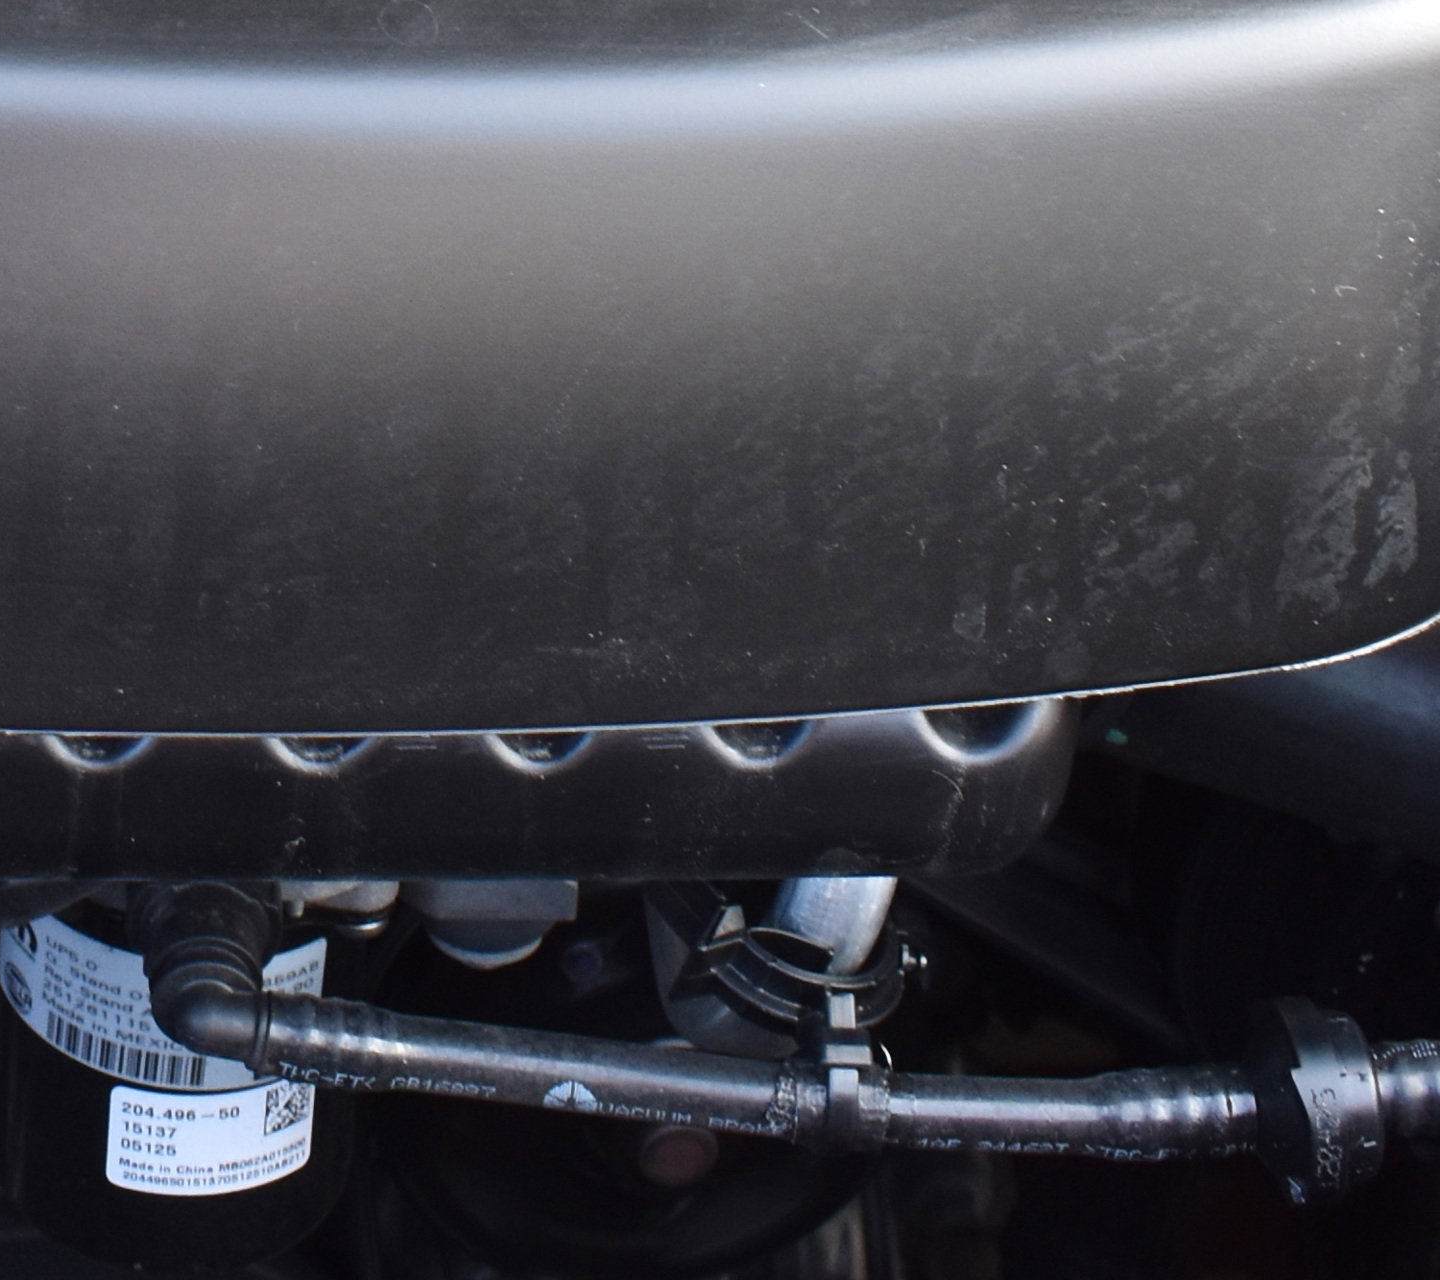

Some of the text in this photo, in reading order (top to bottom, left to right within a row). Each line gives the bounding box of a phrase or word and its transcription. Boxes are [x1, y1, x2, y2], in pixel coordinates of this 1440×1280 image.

[123, 1121, 177, 1138] 15137
[118, 1156, 154, 1172] Made
[176, 1163, 214, 1175] China
